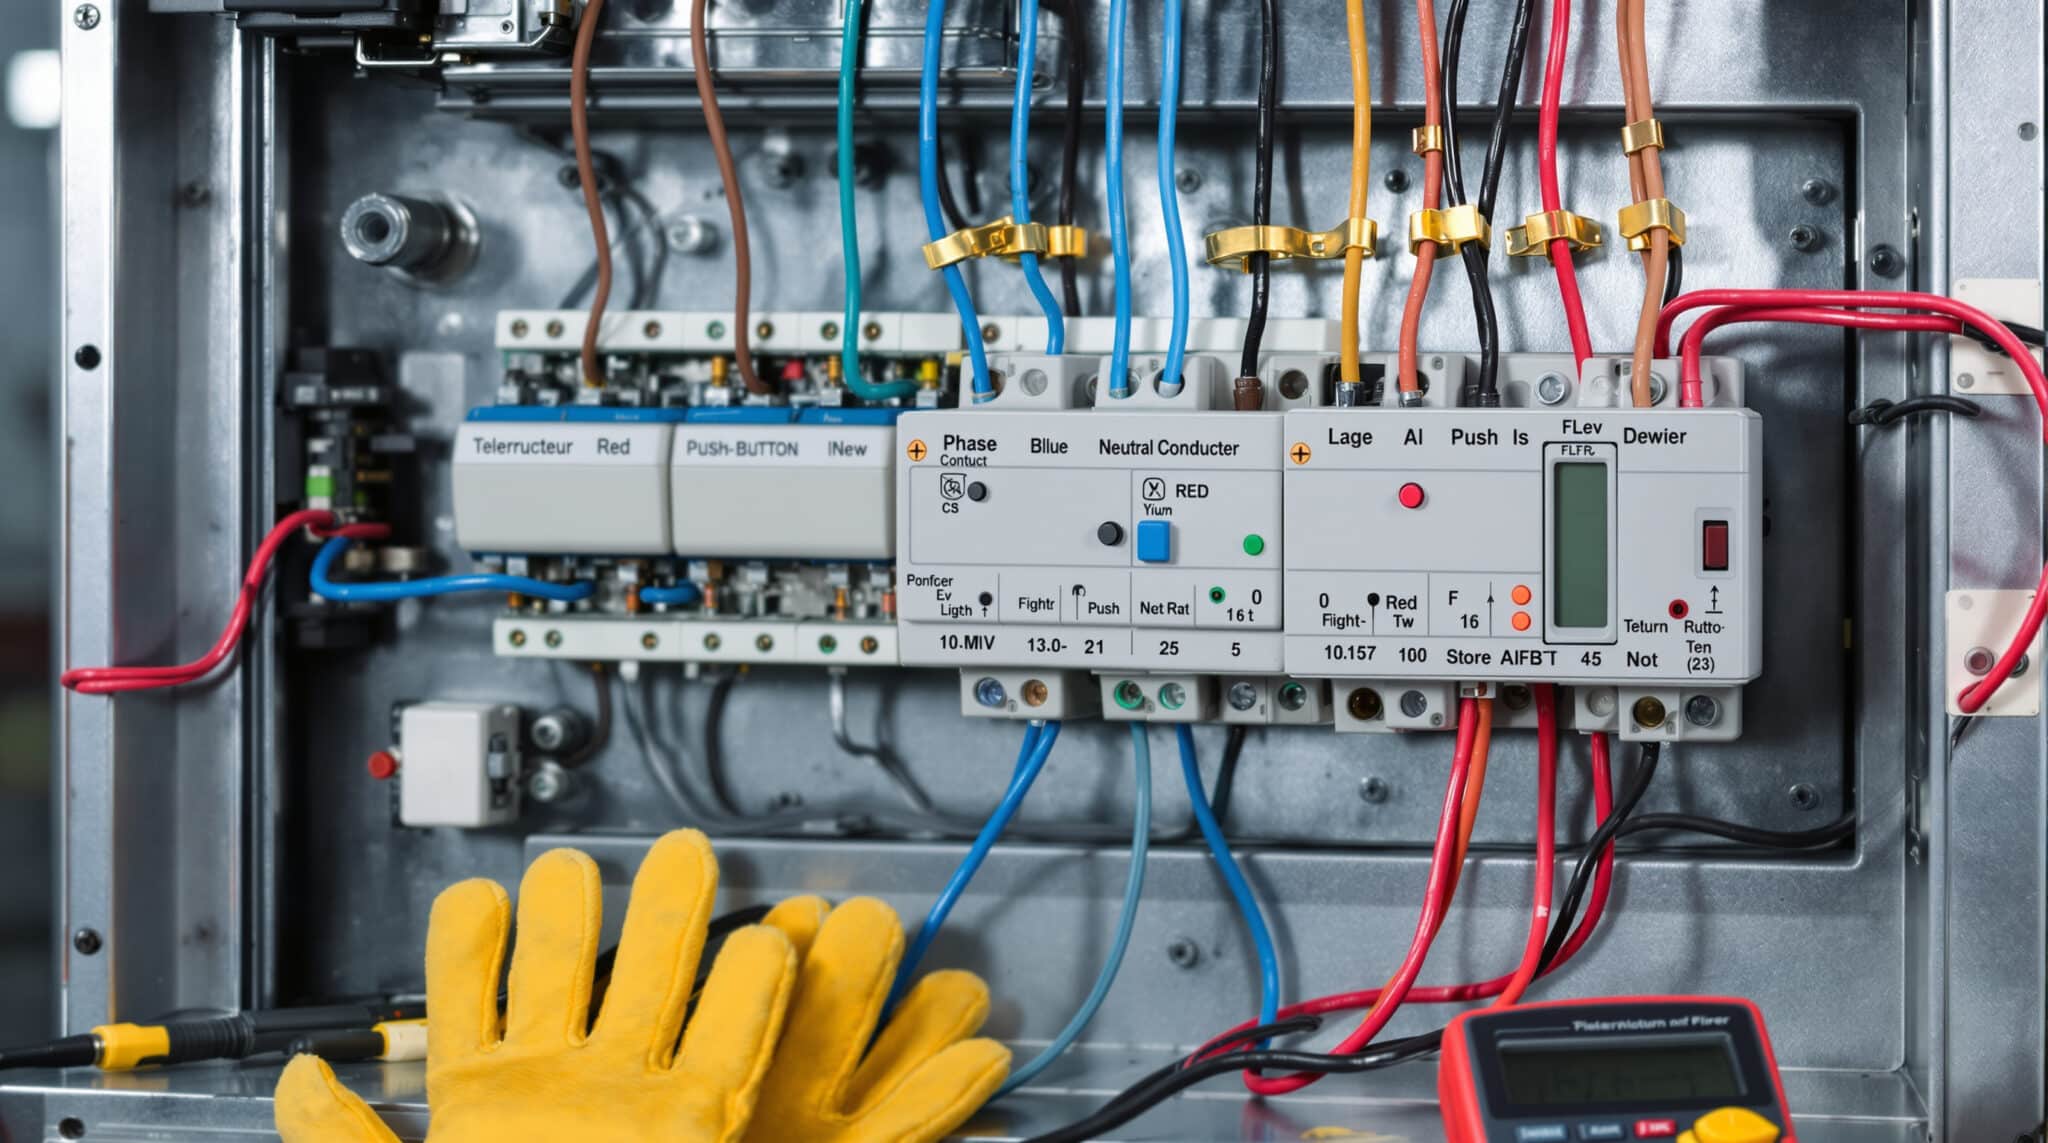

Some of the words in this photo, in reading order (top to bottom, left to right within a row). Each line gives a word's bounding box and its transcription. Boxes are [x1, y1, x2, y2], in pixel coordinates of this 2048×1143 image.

[1563, 420, 1602, 434] FLev
[1329, 428, 1372, 448] Lage
[1452, 429, 1498, 445] Push
[1624, 427, 1687, 444] Dewier
[598, 438, 630, 455] Red
[944, 435, 997, 451] Phase
[1100, 439, 1153, 455] Neutral
[1158, 440, 1239, 456] Conducter
[1176, 484, 1208, 498] RED
[942, 502, 959, 513] CS
[937, 589, 951, 601] Ev
[1449, 591, 1458, 605] F
[1089, 602, 1119, 614] Push
[1141, 602, 1164, 614] Net
[1167, 602, 1189, 615] Rat
[1387, 595, 1417, 610] Red
[941, 604, 972, 618] Ligth
[1393, 614, 1414, 627] Tw
[1461, 614, 1479, 628] 16
[941, 635, 995, 650] 10.MIV
[1085, 640, 1103, 654] 21
[1160, 641, 1178, 655] 25
[1232, 642, 1240, 656] 5
[1686, 640, 1711, 653] Ten
[1325, 645, 1376, 660] 10.157
[1399, 648, 1427, 662] 100
[1447, 649, 1491, 664] Store
[1581, 652, 1601, 666] 45
[1627, 651, 1658, 667] Not
[1687, 657, 1714, 674] (23)
